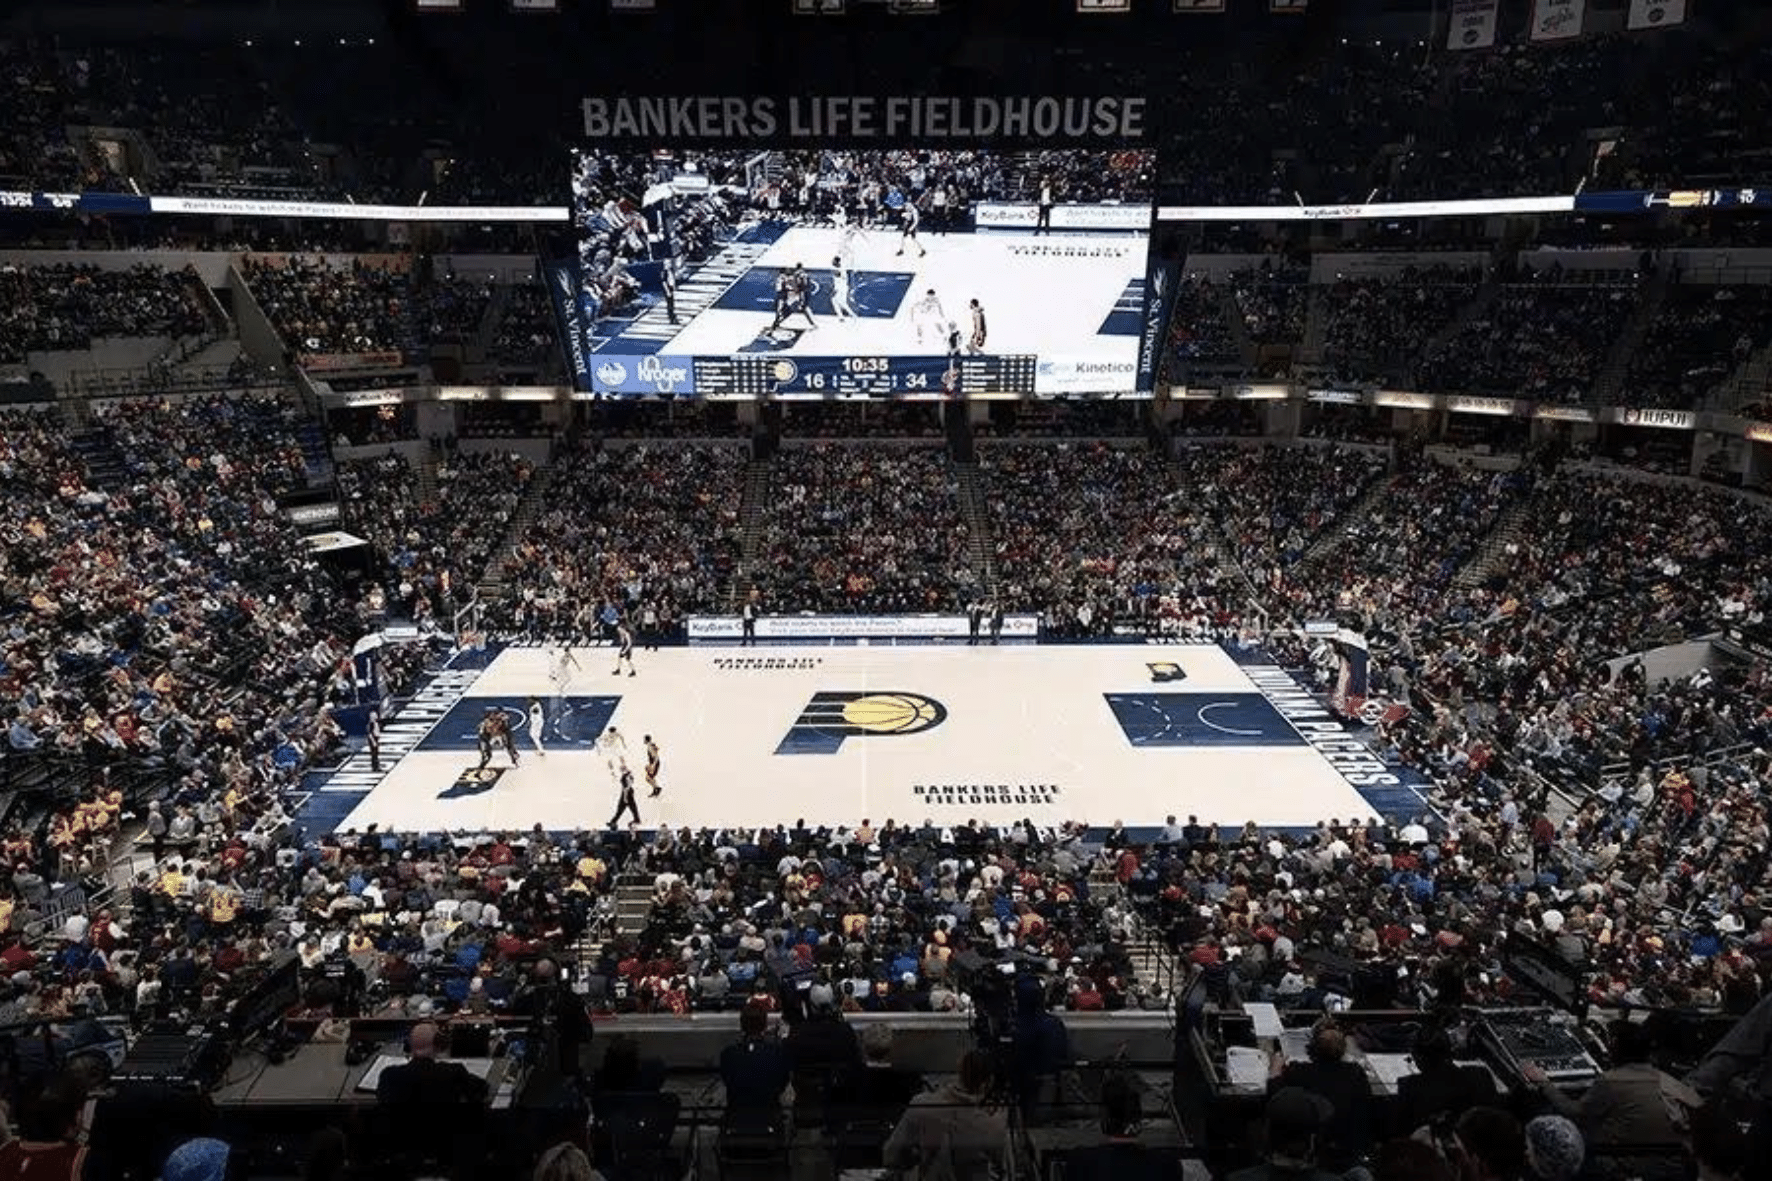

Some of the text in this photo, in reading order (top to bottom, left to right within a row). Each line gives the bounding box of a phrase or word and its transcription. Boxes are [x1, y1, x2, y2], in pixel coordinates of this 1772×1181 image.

[581, 97, 1146, 138] BANKERS LIFE FIELDHOUSE
[842, 358, 889, 372] 10:35
[1076, 361, 1134, 374] Kinetico
[637, 355, 688, 393] Kroger
[803, 373, 825, 389] 16
[905, 373, 928, 389] 34
[1294, 720, 1401, 786] PACERS
[913, 784, 1060, 795] BANKERS LIFE
[924, 794, 1055, 805] FIELDHOUSE
